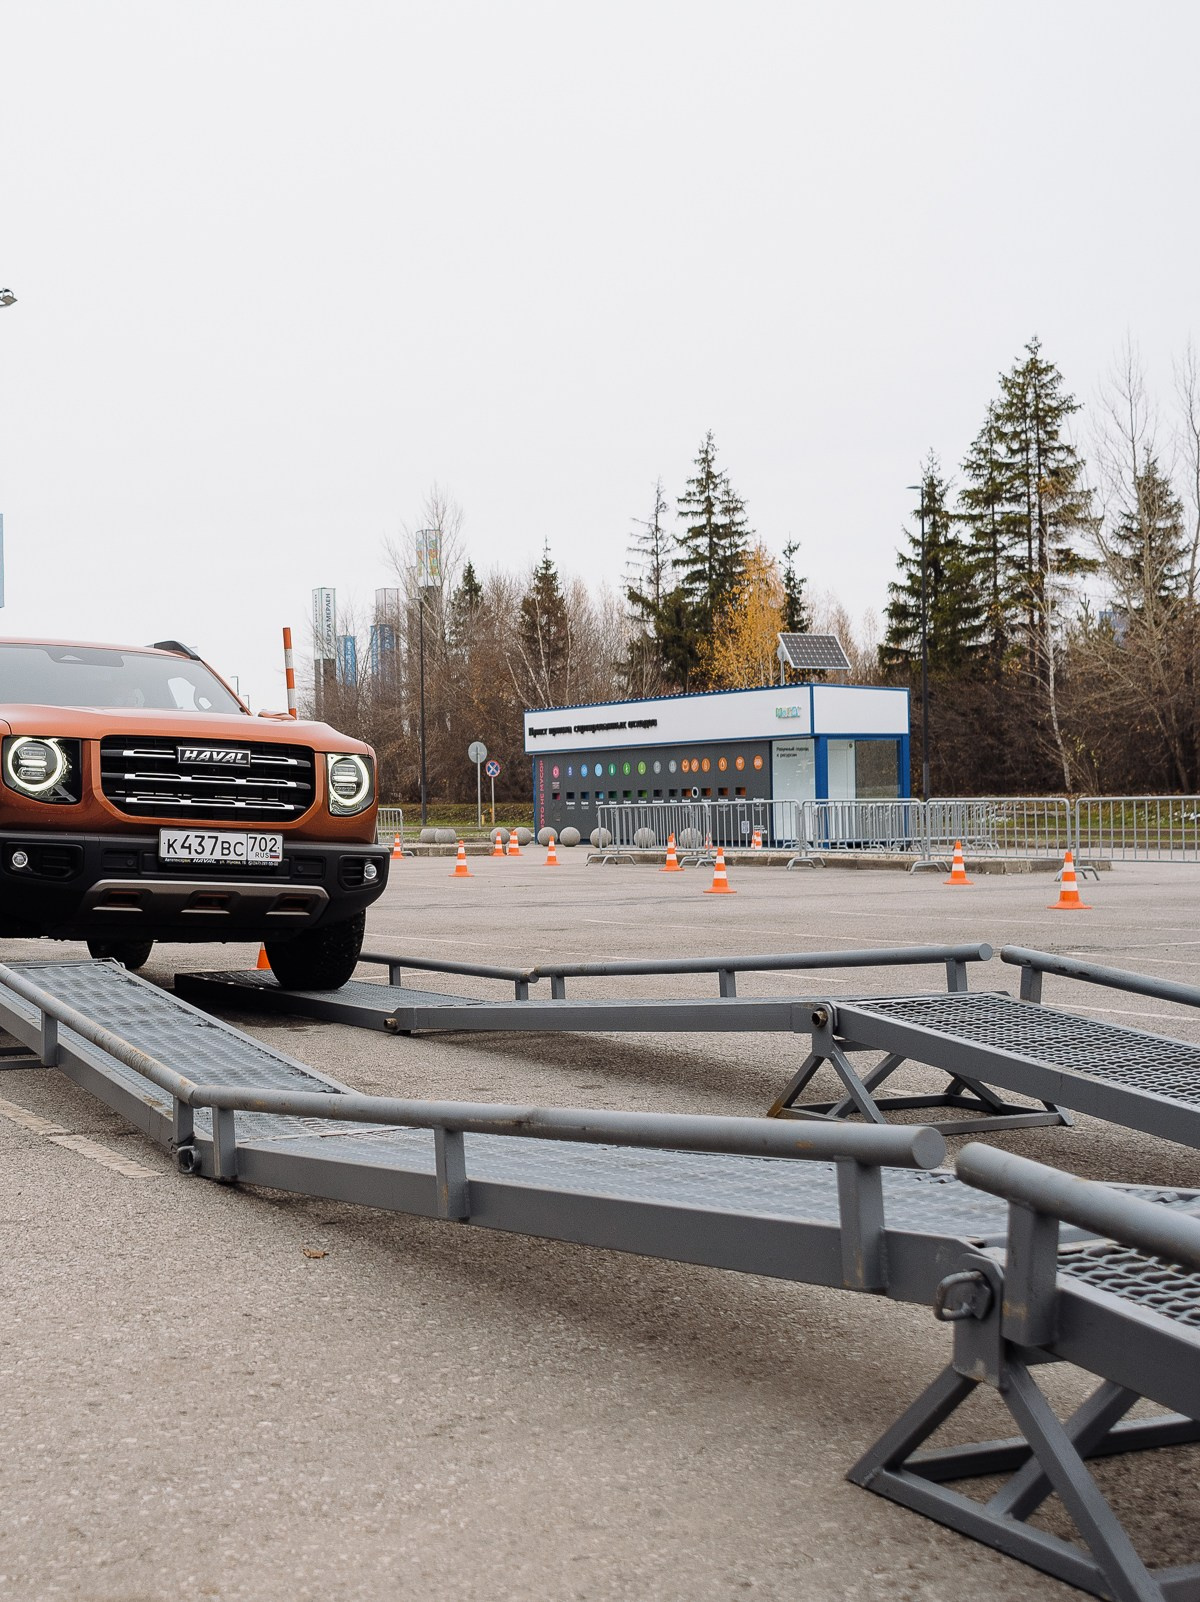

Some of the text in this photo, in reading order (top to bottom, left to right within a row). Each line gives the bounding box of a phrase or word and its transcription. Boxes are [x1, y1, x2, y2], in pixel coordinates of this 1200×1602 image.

[182, 750, 247, 763] HAVAL
[167, 834, 278, 857] К437ВС 702
